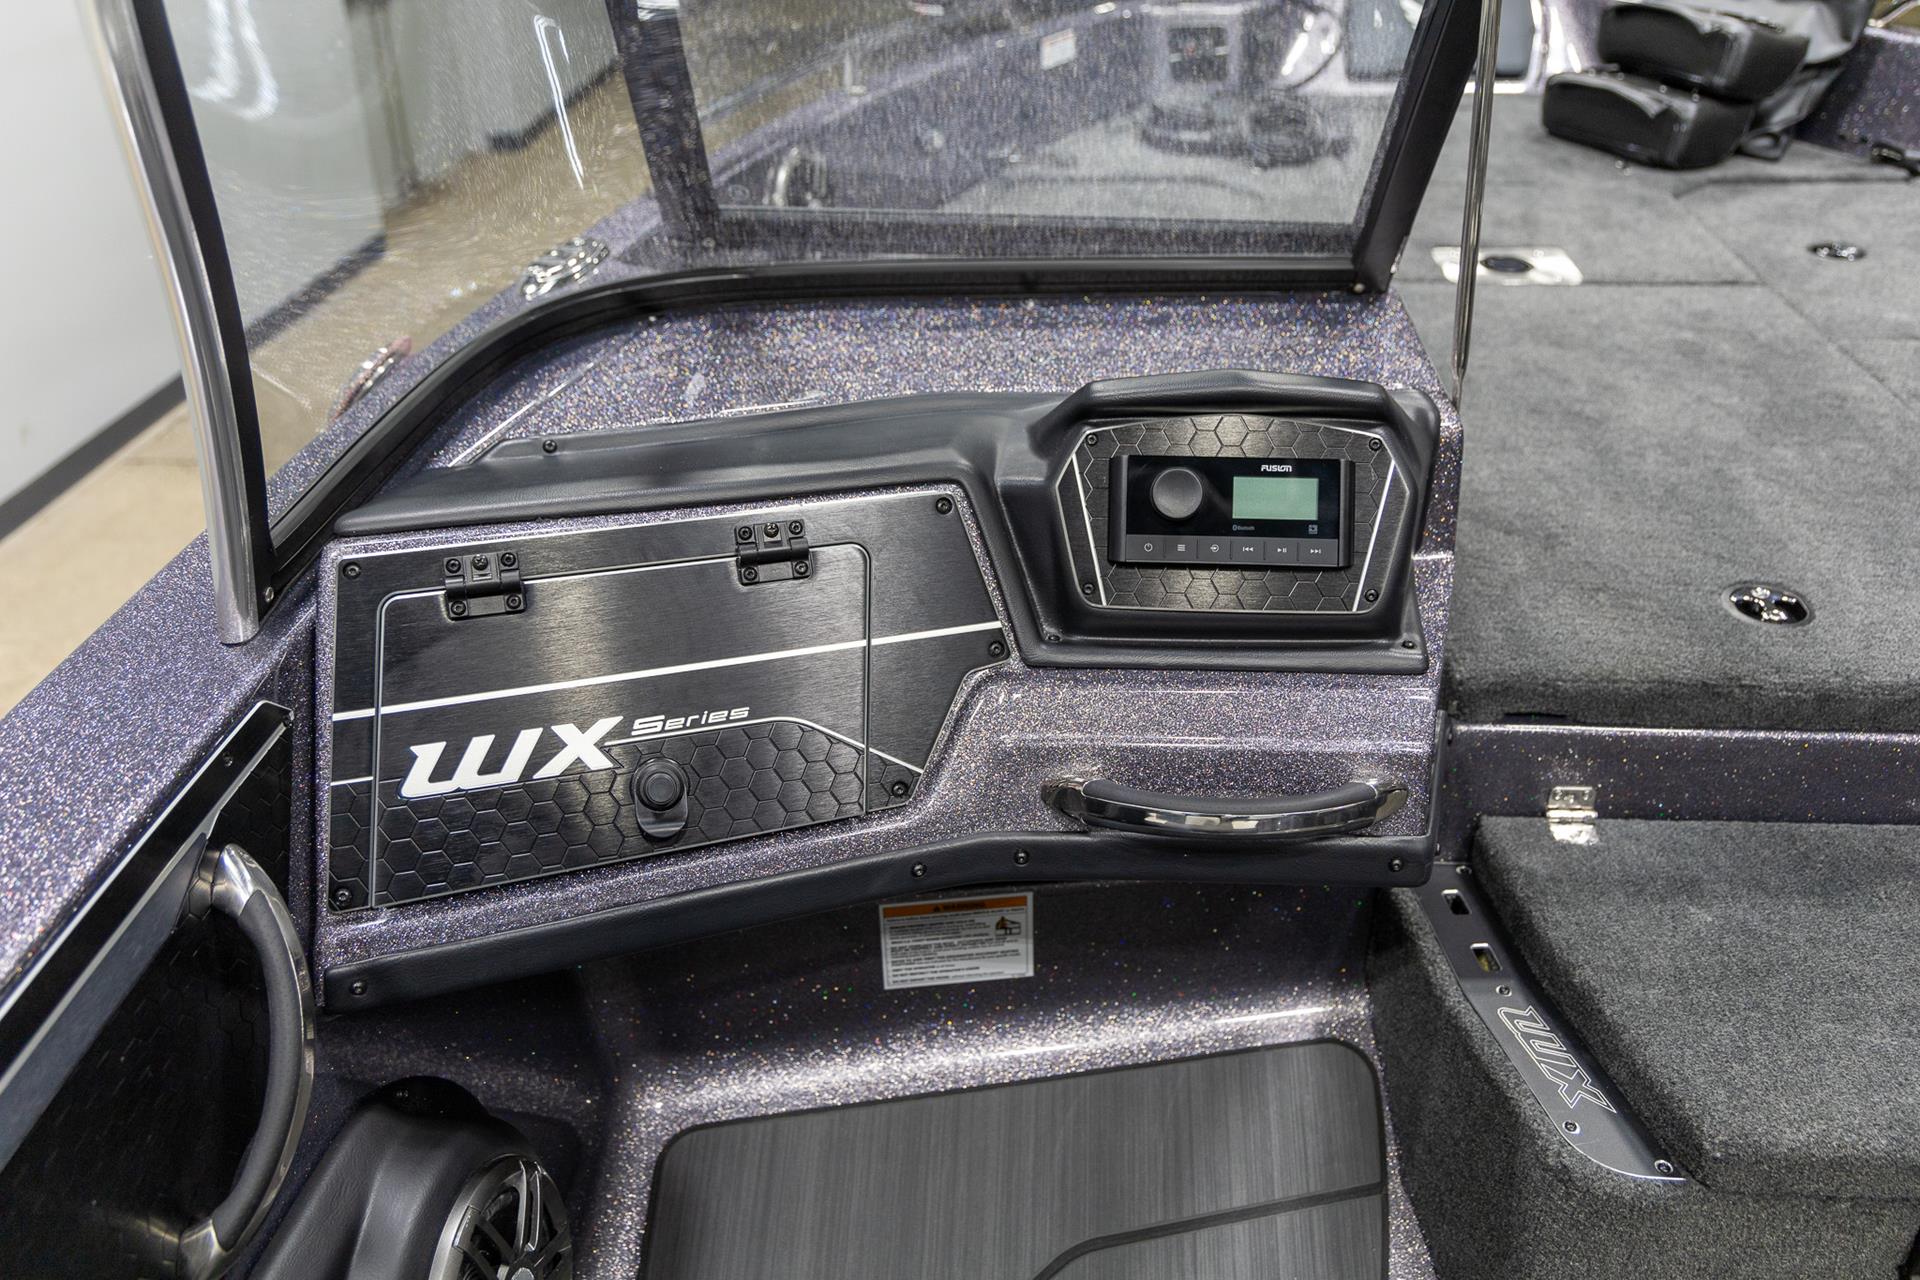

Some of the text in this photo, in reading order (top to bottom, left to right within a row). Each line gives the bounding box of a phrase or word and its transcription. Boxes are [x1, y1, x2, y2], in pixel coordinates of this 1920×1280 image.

[398, 706, 750, 800] WX Series
[1497, 1005, 1617, 1114] WX
